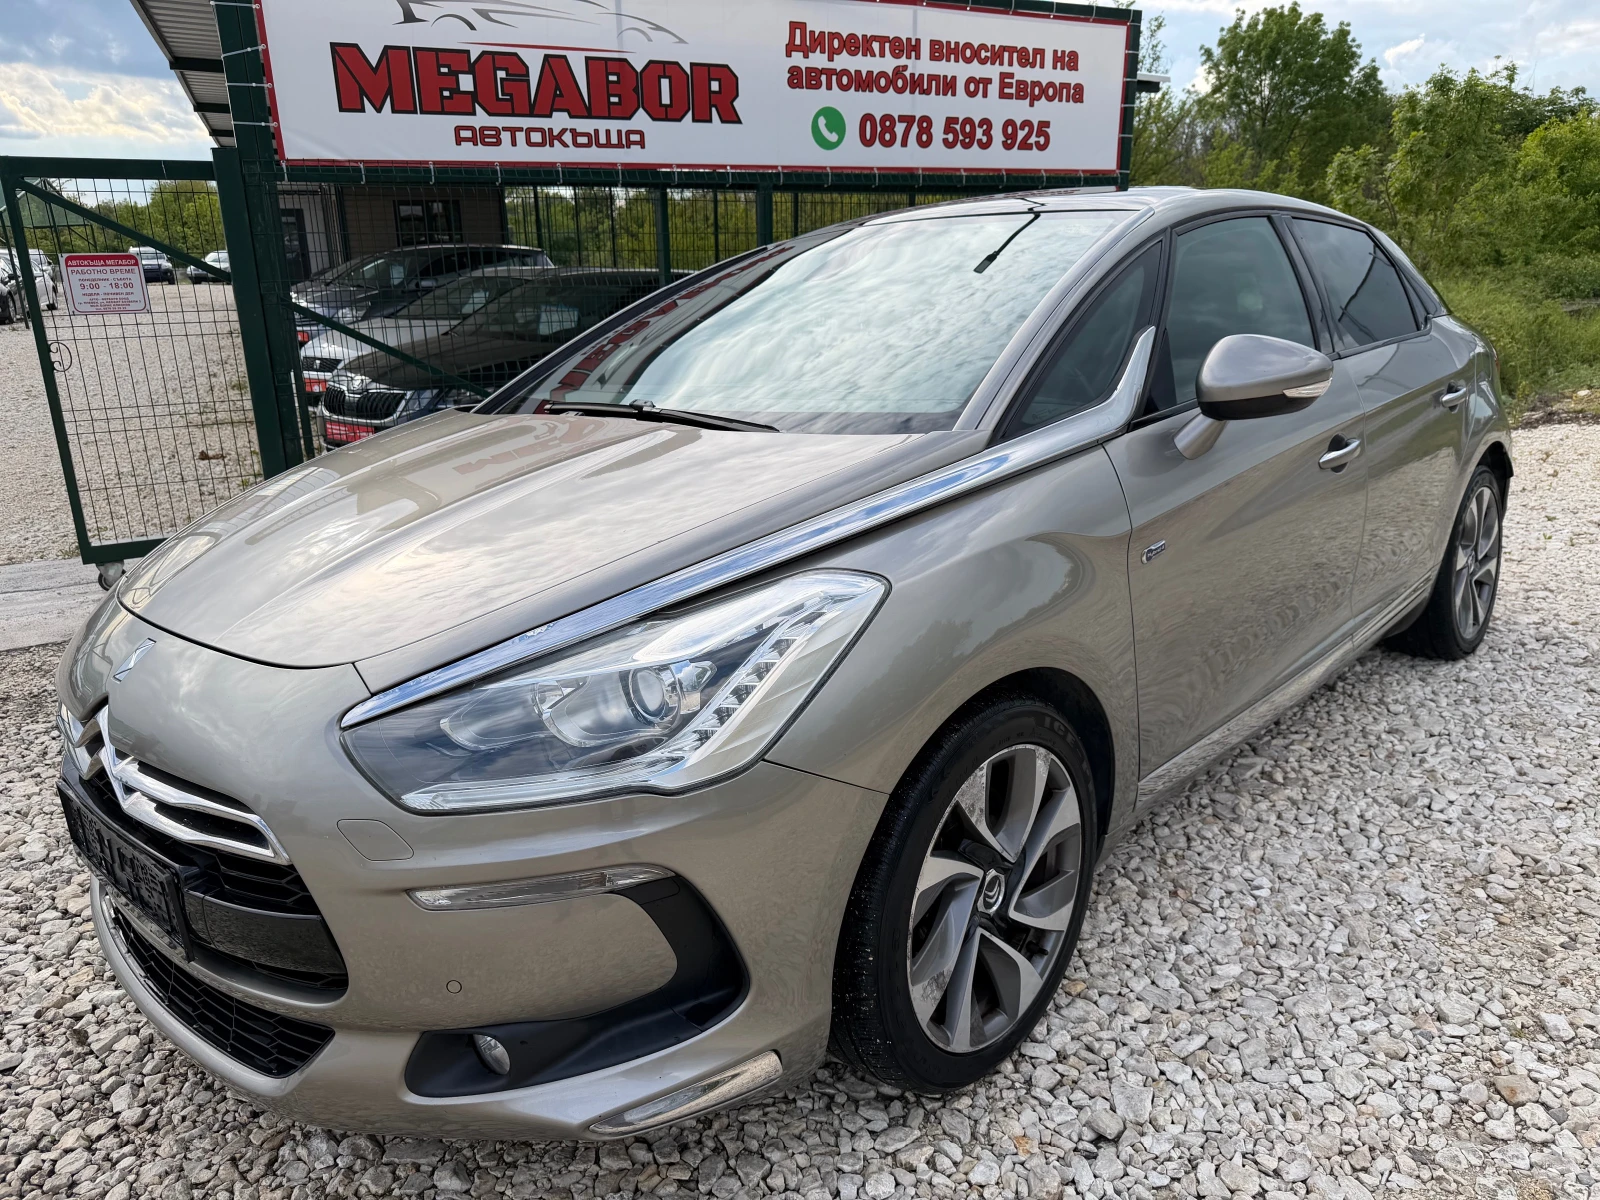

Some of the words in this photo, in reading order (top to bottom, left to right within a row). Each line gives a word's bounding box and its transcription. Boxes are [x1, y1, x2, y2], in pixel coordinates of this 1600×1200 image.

[786, 21, 921, 61] Директен
[929, 39, 1045, 69] вносител
[1052, 48, 1079, 71] на
[329, 42, 743, 124] MEGABOR
[787, 65, 957, 97] автомобили
[964, 76, 992, 98] от
[998, 72, 1084, 107] Европа
[454, 125, 646, 149] АВТОКЪЩА
[859, 113, 933, 149] 0878
[942, 117, 993, 150] 593
[1002, 119, 1051, 151] 925
